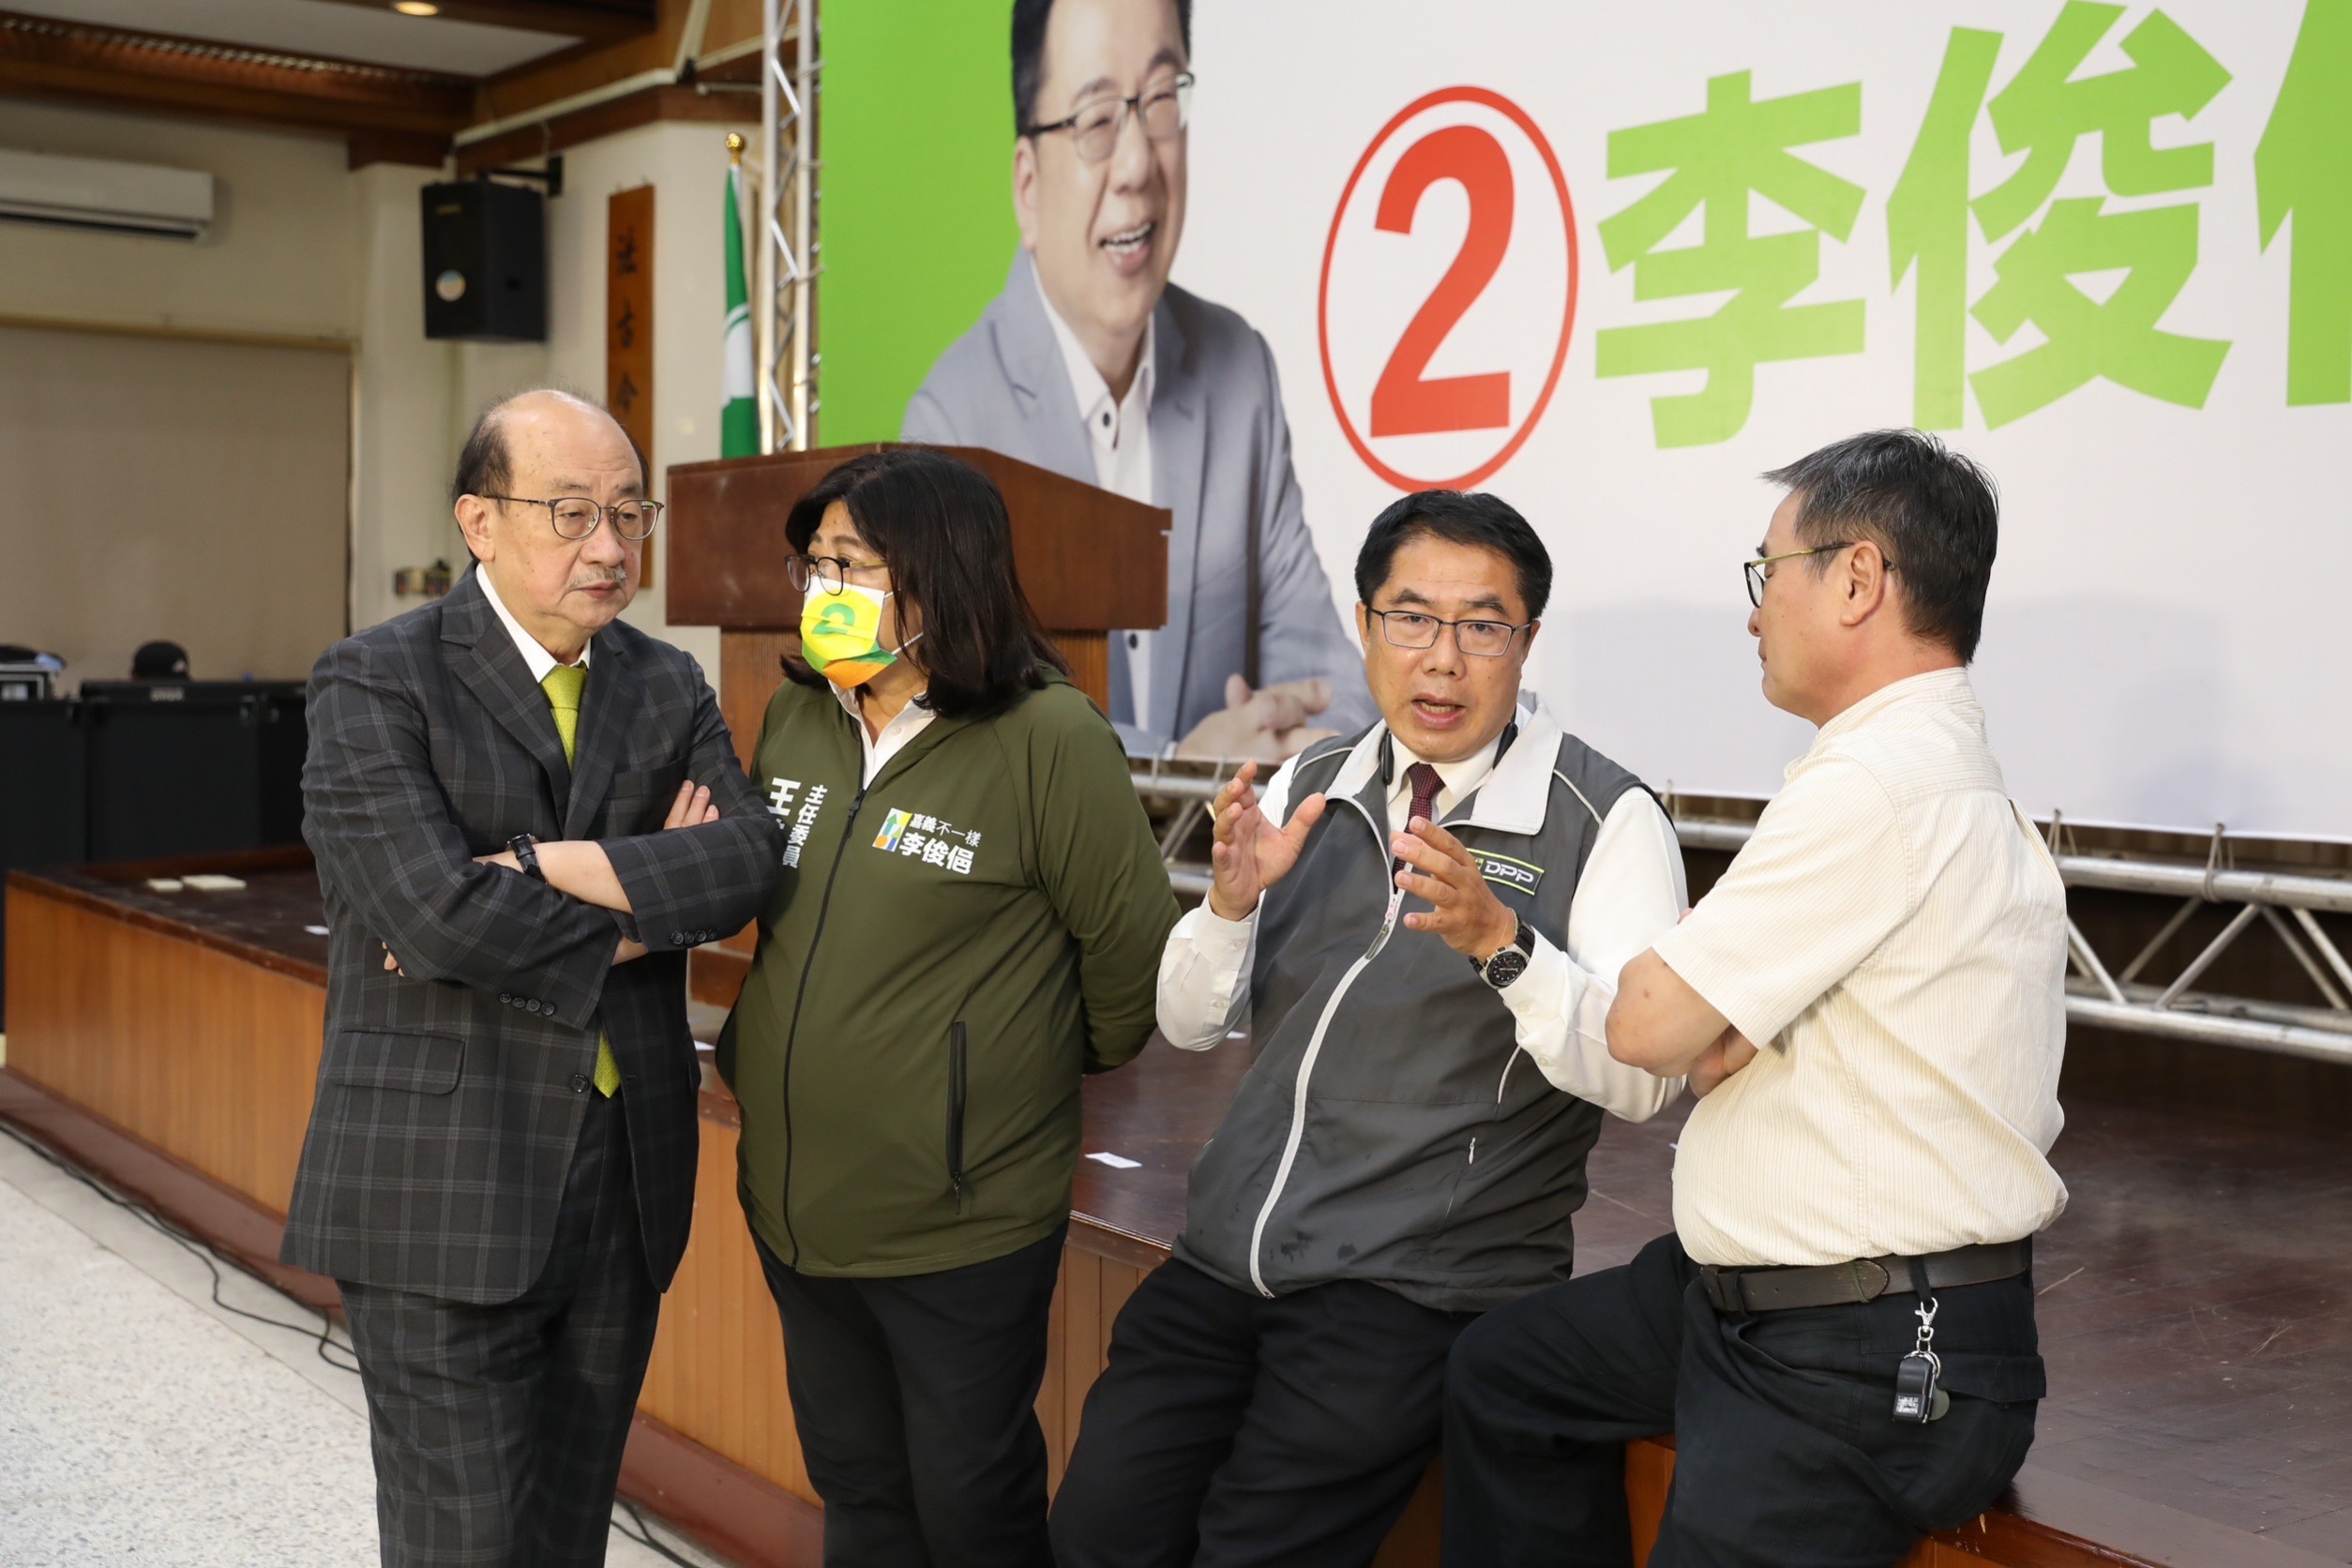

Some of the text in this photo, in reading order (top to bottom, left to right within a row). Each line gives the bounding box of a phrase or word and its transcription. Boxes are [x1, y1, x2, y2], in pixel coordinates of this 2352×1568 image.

[1370, 125, 1515, 437] 2
[812, 603, 855, 635] 2
[766, 776, 802, 830] 王
[782, 784, 828, 868] 主任委員
[909, 813, 982, 848] 嘉義不一樣
[1485, 860, 1534, 883] DPP
